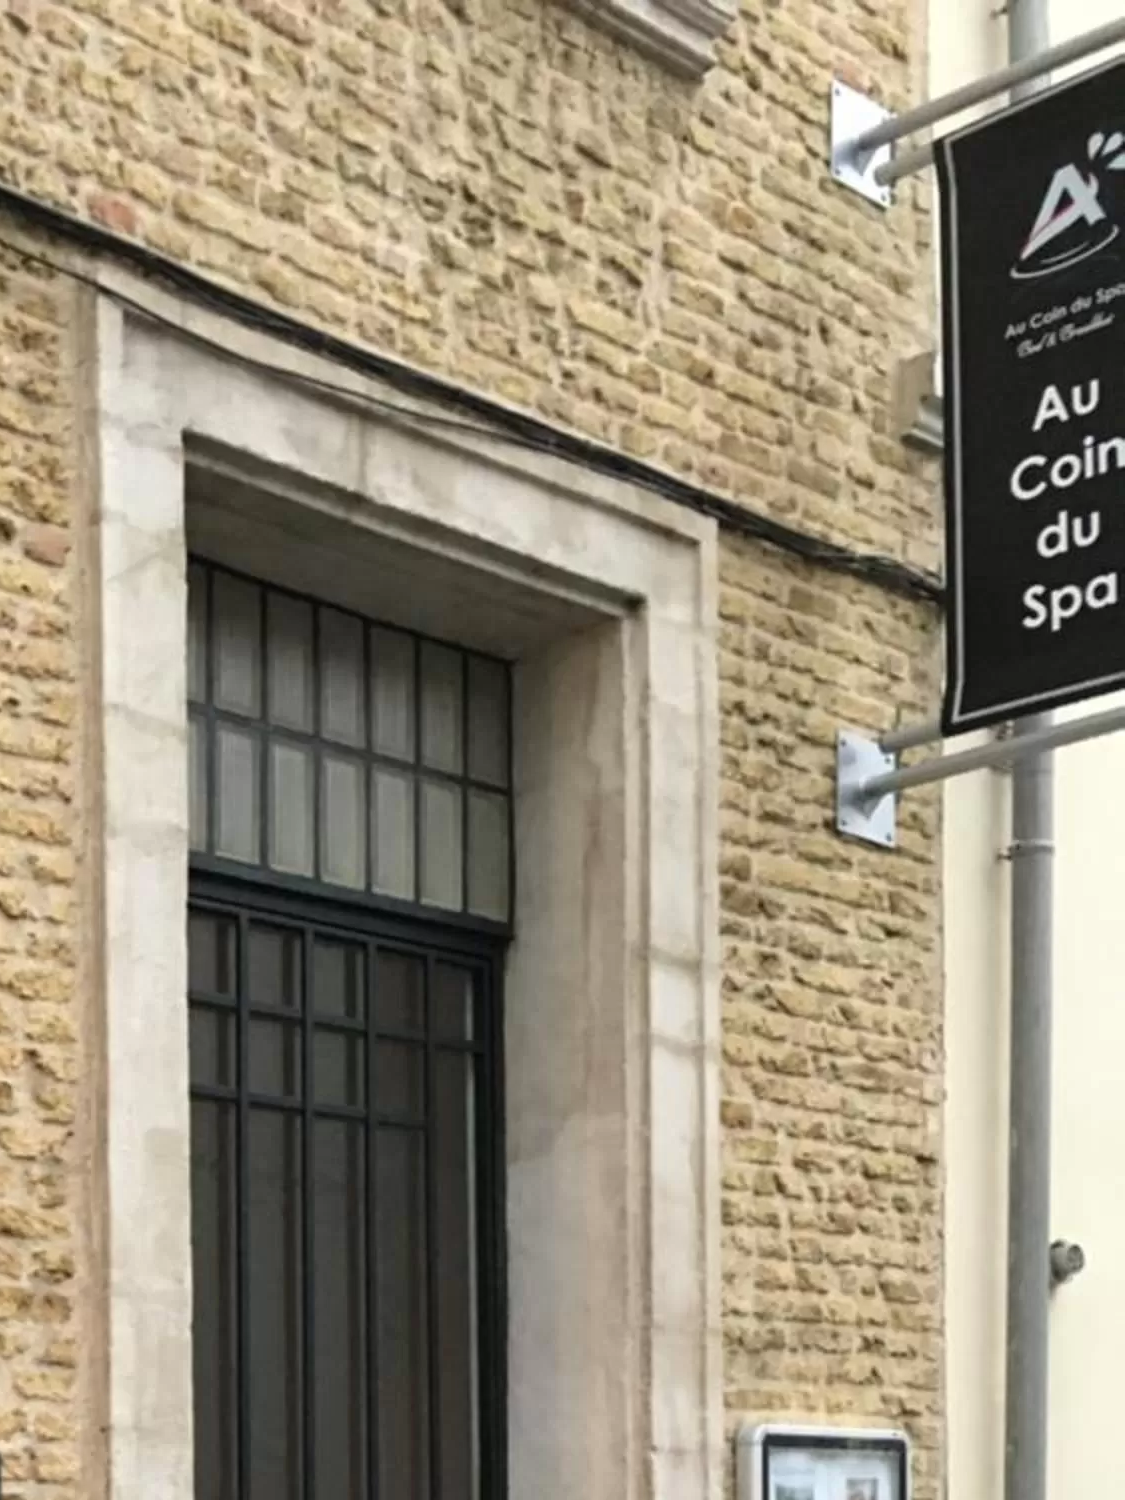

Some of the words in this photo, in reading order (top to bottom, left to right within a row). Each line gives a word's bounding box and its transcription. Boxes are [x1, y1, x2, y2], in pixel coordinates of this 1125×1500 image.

[1004, 322, 1026, 340] Au
[1029, 312, 1067, 329] Coin
[1070, 296, 1092, 314] du
[1032, 379, 1099, 432] Au
[1010, 436, 1125, 500] Coin
[1037, 510, 1100, 557] du
[1022, 572, 1117, 632] Spa
